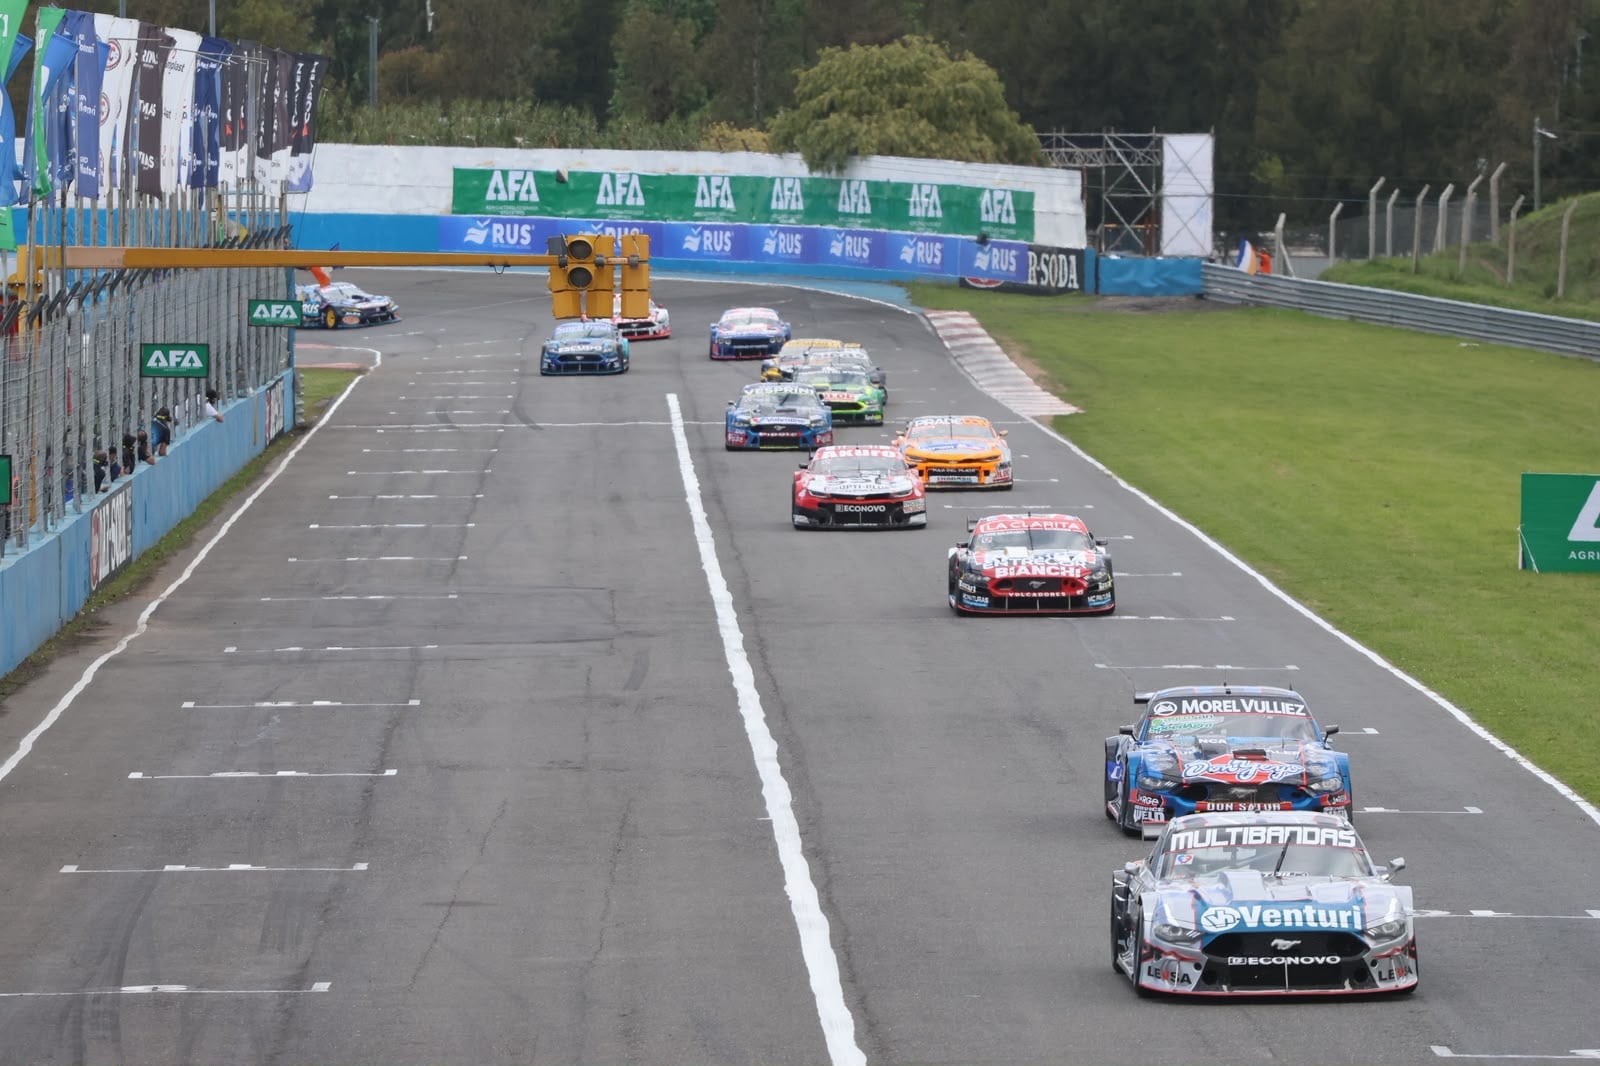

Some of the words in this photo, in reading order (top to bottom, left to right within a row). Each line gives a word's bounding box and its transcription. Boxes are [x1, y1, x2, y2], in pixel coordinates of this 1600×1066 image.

[485, 170, 540, 202] AFA
[596, 173, 645, 206] AFA
[695, 176, 735, 209] AFA
[770, 178, 805, 210] AFA
[838, 180, 872, 214] AFA
[909, 184, 943, 217] AFA
[980, 189, 1017, 224] AFA
[492, 224, 531, 246] RUS
[703, 229, 731, 251] RUS
[779, 233, 801, 254] RUS
[845, 236, 870, 258] RUS
[917, 241, 941, 264] RUS
[992, 247, 1016, 272] RUS
[1027, 251, 1080, 289] R-SODA
[252, 304, 298, 319] AFA
[302, 303, 319, 313] RUS
[146, 350, 203, 368] AFA
[843, 504, 886, 513] ECONOVO
[987, 522, 1008, 531] LA
[1010, 521, 1080, 530] CLARITA
[995, 564, 1081, 578] BIANCHI
[1181, 699, 1241, 714] MOREL
[1240, 699, 1306, 716] VULLIEZ
[1206, 802, 1234, 811] DON
[1239, 802, 1281, 811] SATUR
[1170, 826, 1356, 850] MULTIBANDAS
[1239, 904, 1364, 929] Venturi
[1248, 956, 1341, 965] ECONOVO
